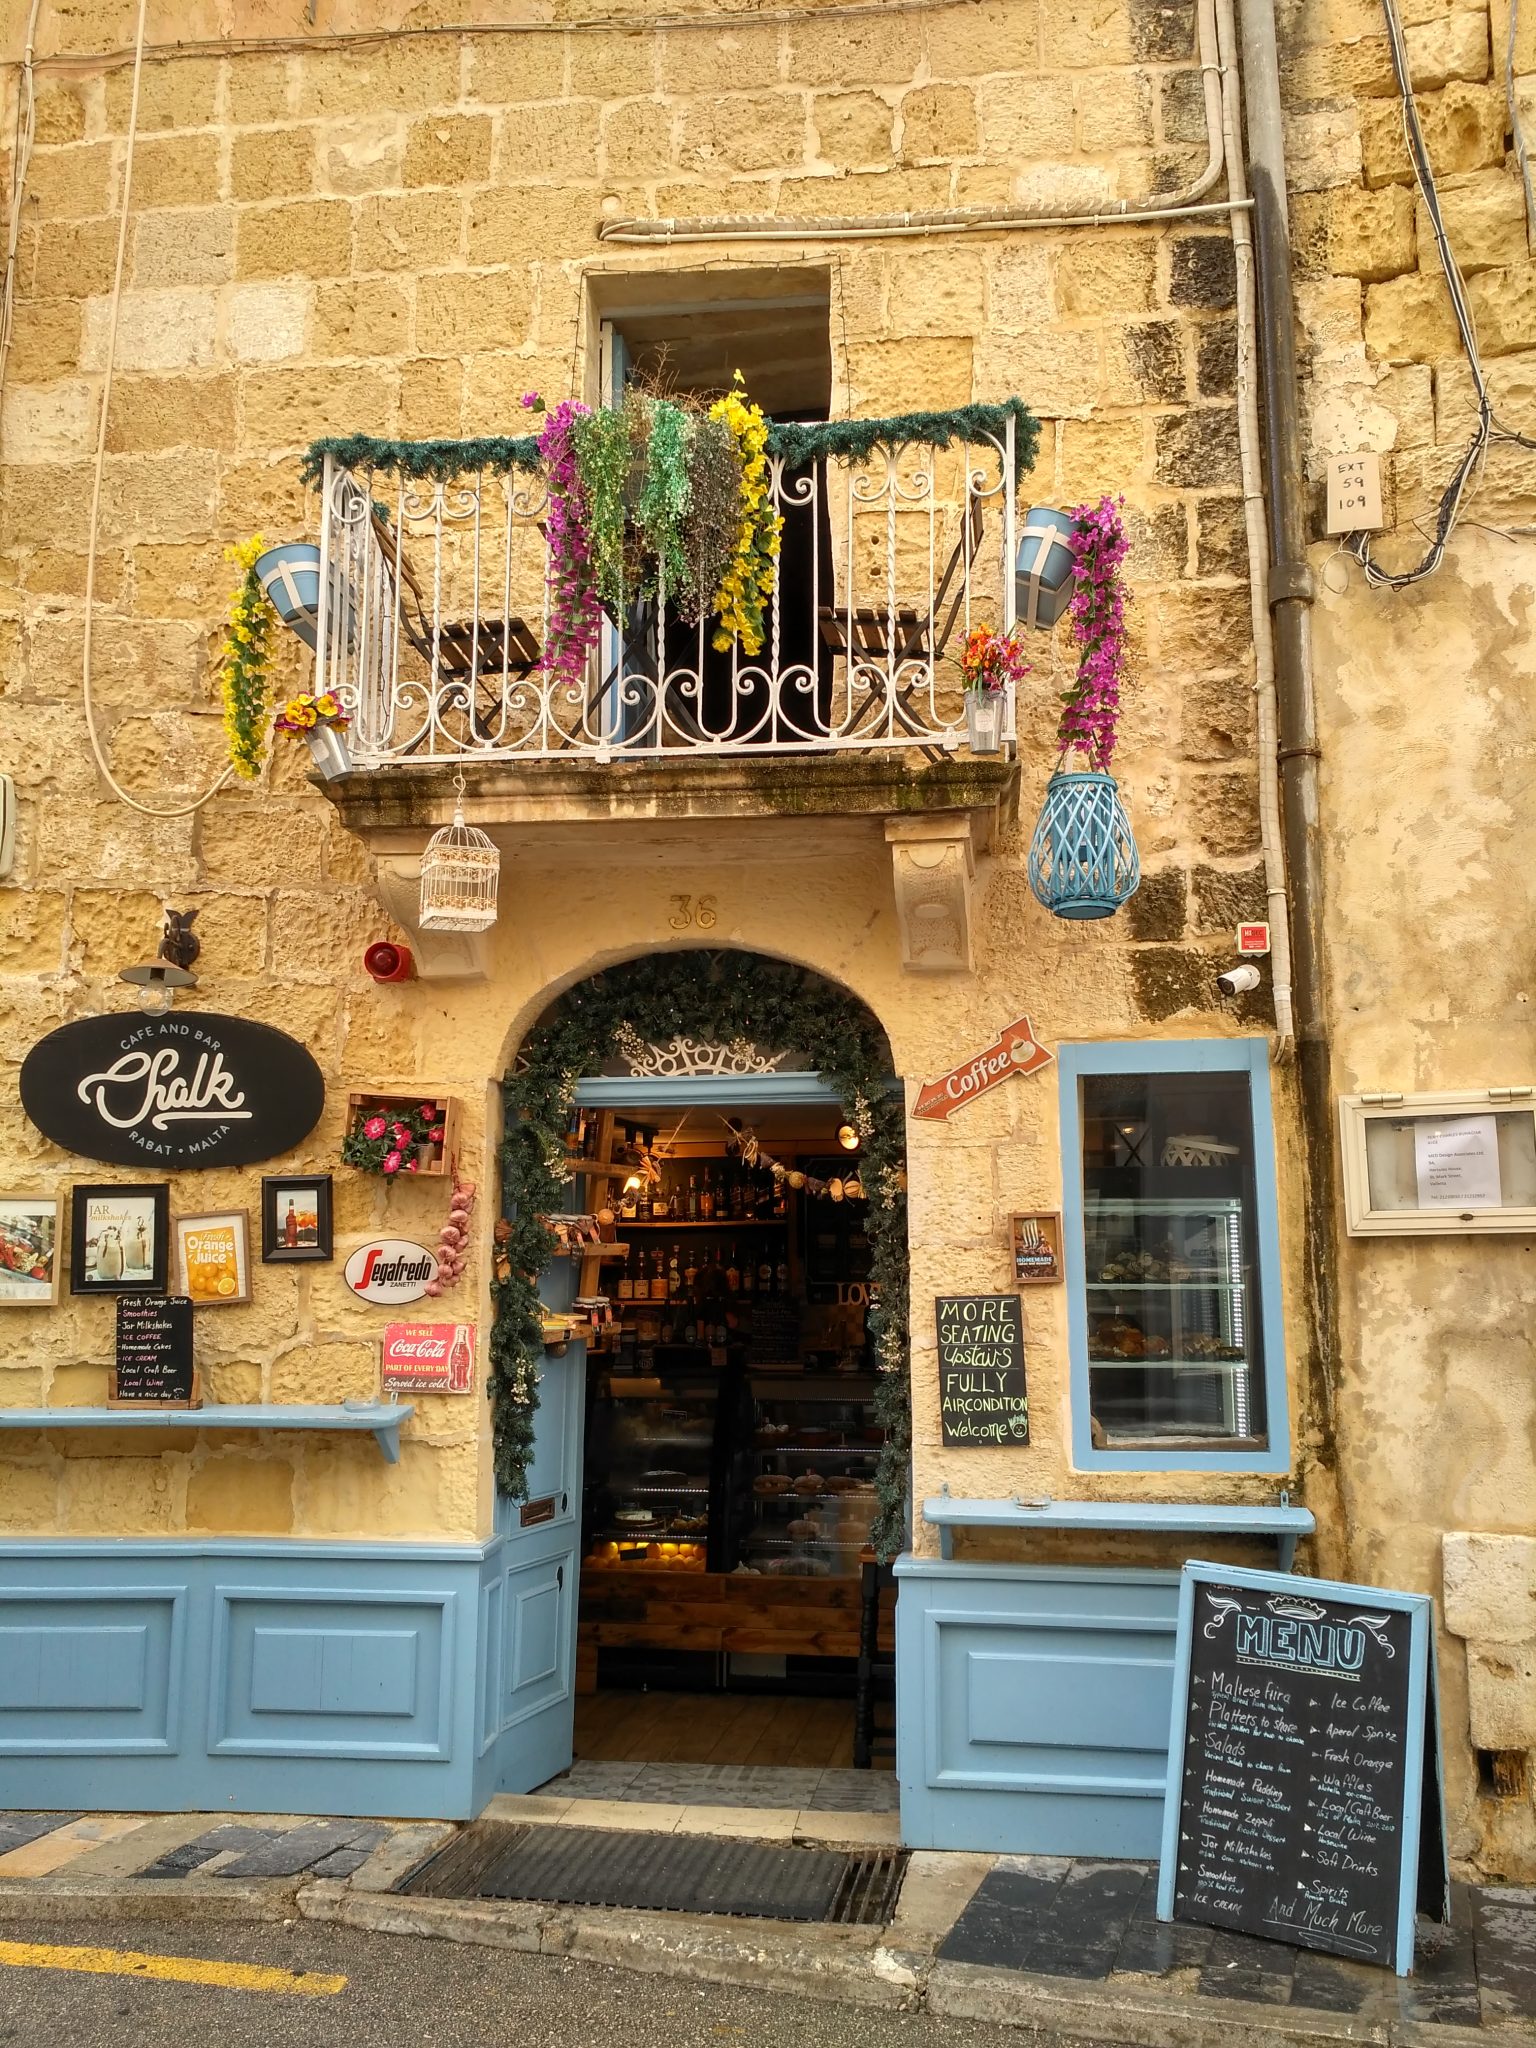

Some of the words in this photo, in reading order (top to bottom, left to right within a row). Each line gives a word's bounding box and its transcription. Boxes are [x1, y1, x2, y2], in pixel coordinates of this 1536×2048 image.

[1338, 462, 1365, 473] EXT
[1343, 477, 1364, 488] 59
[1340, 495, 1365, 509] 109
[669, 895, 717, 929] 36
[120, 1026, 154, 1050] CAFE
[159, 1024, 189, 1035] AND
[194, 1030, 221, 1051] BAR
[946, 1052, 1011, 1099] Coffee
[77, 1048, 245, 1129] Chalk
[128, 1130, 172, 1156] RABAT
[189, 1124, 230, 1154] MALTA
[89, 1205, 109, 1217] JAR
[187, 1236, 234, 1252] Orange
[354, 1249, 431, 1289] Segafredo
[123, 1298, 141, 1307] Fresh
[145, 1297, 167, 1308] Orange
[170, 1297, 187, 1305] Juice
[837, 1283, 880, 1305] LOV
[123, 1309, 157, 1317] Smoothies
[940, 1300, 1014, 1322] MORE
[122, 1321, 135, 1330] Jar
[137, 1320, 172, 1330] Milkshakes
[940, 1324, 1015, 1344] SEATING
[121, 1343, 151, 1351] Homemade
[390, 1339, 448, 1358] Coca-Cola
[122, 1365, 140, 1374] Local
[162, 1365, 178, 1373] Beer
[124, 1378, 142, 1386] Local
[385, 1378, 415, 1387] Served
[429, 1378, 447, 1388] cold
[947, 1372, 1007, 1392] FULLY
[119, 1390, 135, 1398] Have
[160, 1391, 172, 1399] day
[943, 1396, 1028, 1415] AIRCONDITION
[945, 1418, 1008, 1443] Welcome
[1236, 1614, 1366, 1670] MENU
[1211, 1671, 1261, 1698] Maltese
[1330, 1692, 1347, 1710] Ice
[1352, 1695, 1391, 1713] Coffee
[1208, 1700, 1258, 1727] Platters
[1261, 1716, 1270, 1727] to
[1273, 1716, 1298, 1734] share
[1326, 1722, 1360, 1739] Aperol
[1362, 1725, 1398, 1743] Spritz
[1206, 1731, 1246, 1757] Salads
[1324, 1748, 1350, 1764] Fresh
[1353, 1752, 1394, 1774] Orange
[1202, 1784, 1235, 1800] Traditional
[1205, 1769, 1246, 1788] Homemade
[1251, 1778, 1283, 1802] Pudding
[1323, 1773, 1372, 1793] Waffles
[1202, 1801, 1240, 1820] Homemade
[1321, 1797, 1352, 1814] Local
[1350, 1801, 1372, 1816] Craft
[1371, 1806, 1394, 1821] Beer
[1318, 1824, 1346, 1840] Local
[1347, 1827, 1377, 1844] Wine
[1200, 1832, 1219, 1849] Jar
[1223, 1840, 1272, 1860] Milkshakes
[1197, 1863, 1237, 1883] Smoothies
[1316, 1850, 1339, 1867] Soft
[1341, 1854, 1379, 1877] Drinks
[1309, 1879, 1349, 1899] Spirits
[1194, 1893, 1208, 1904] ICE
[1213, 1899, 1243, 1916] CREAM
[1268, 1895, 1298, 1921] And
[1303, 1901, 1339, 1934] Much
[1345, 1910, 1383, 1936] More
